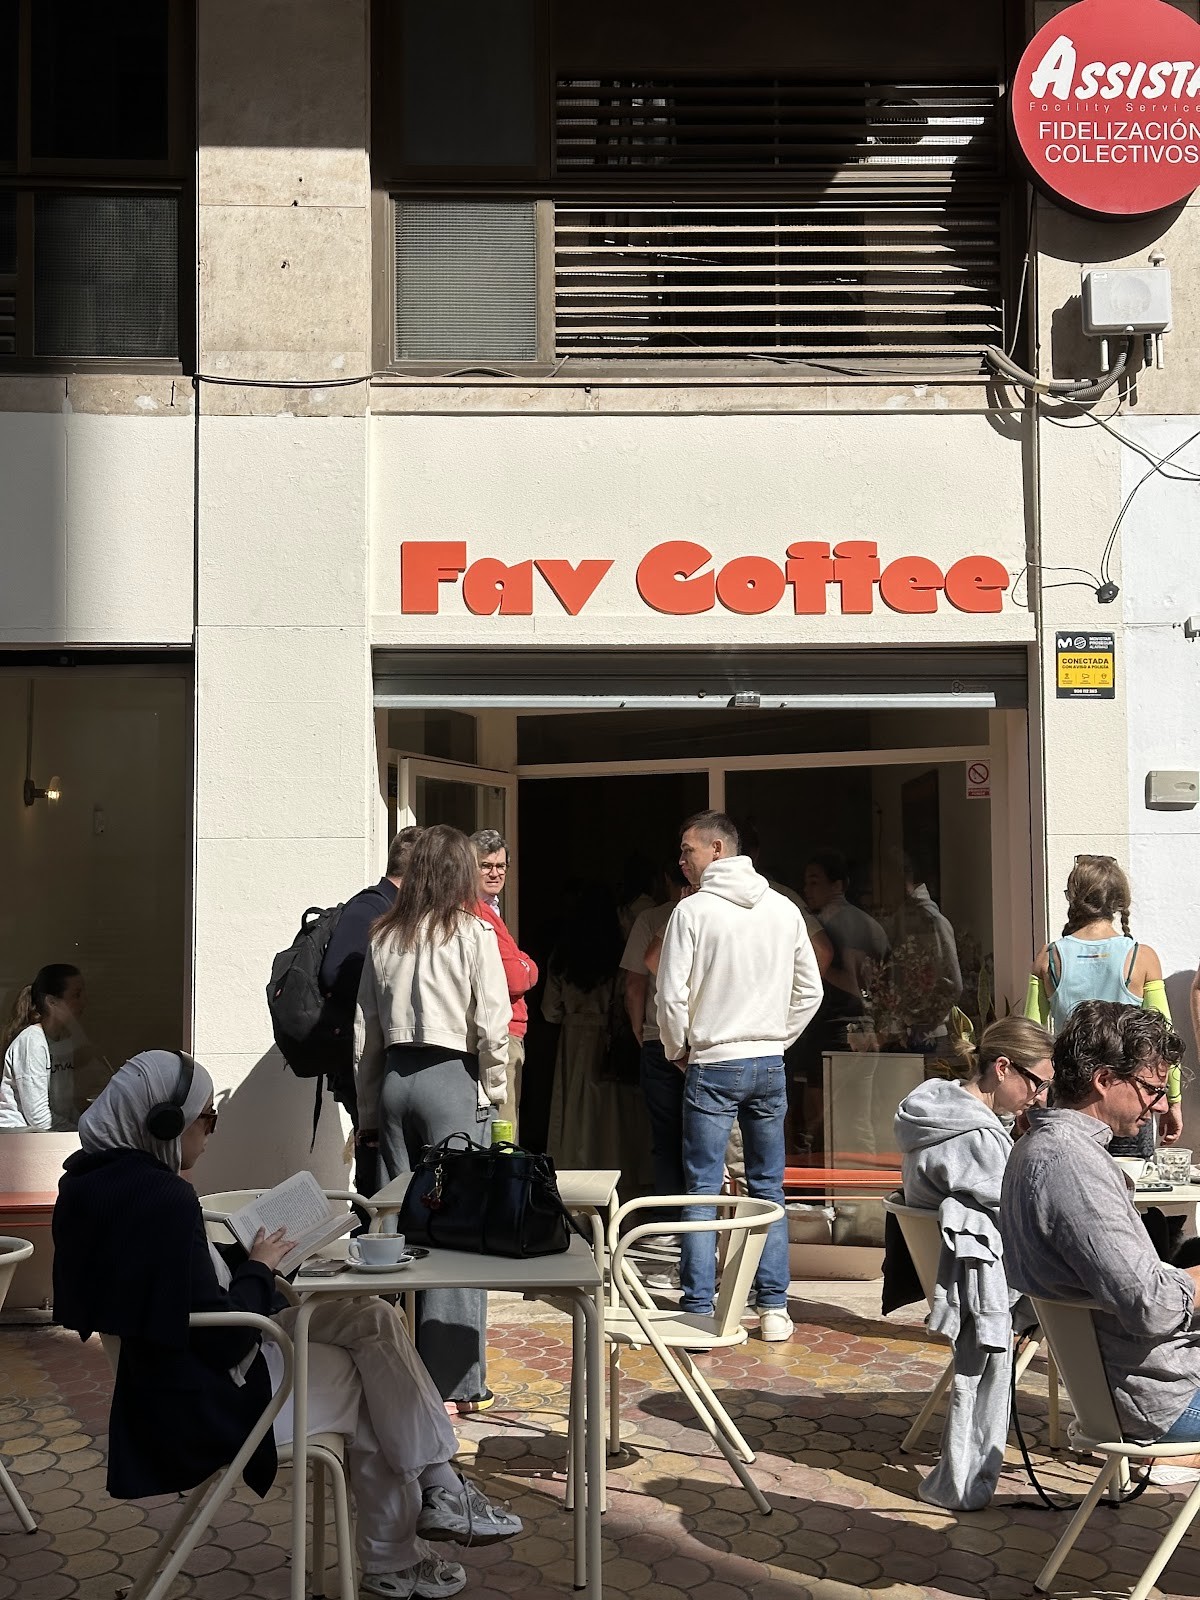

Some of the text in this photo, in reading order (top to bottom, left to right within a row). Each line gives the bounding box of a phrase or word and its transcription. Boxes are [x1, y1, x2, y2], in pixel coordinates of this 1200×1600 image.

[1029, 101, 1110, 114] Facility
[1039, 118, 1200, 140] FIDELIZACIÓN
[1045, 144, 1199, 164] COLECTIVOS
[400, 540, 1010, 615] Fav Coffee
